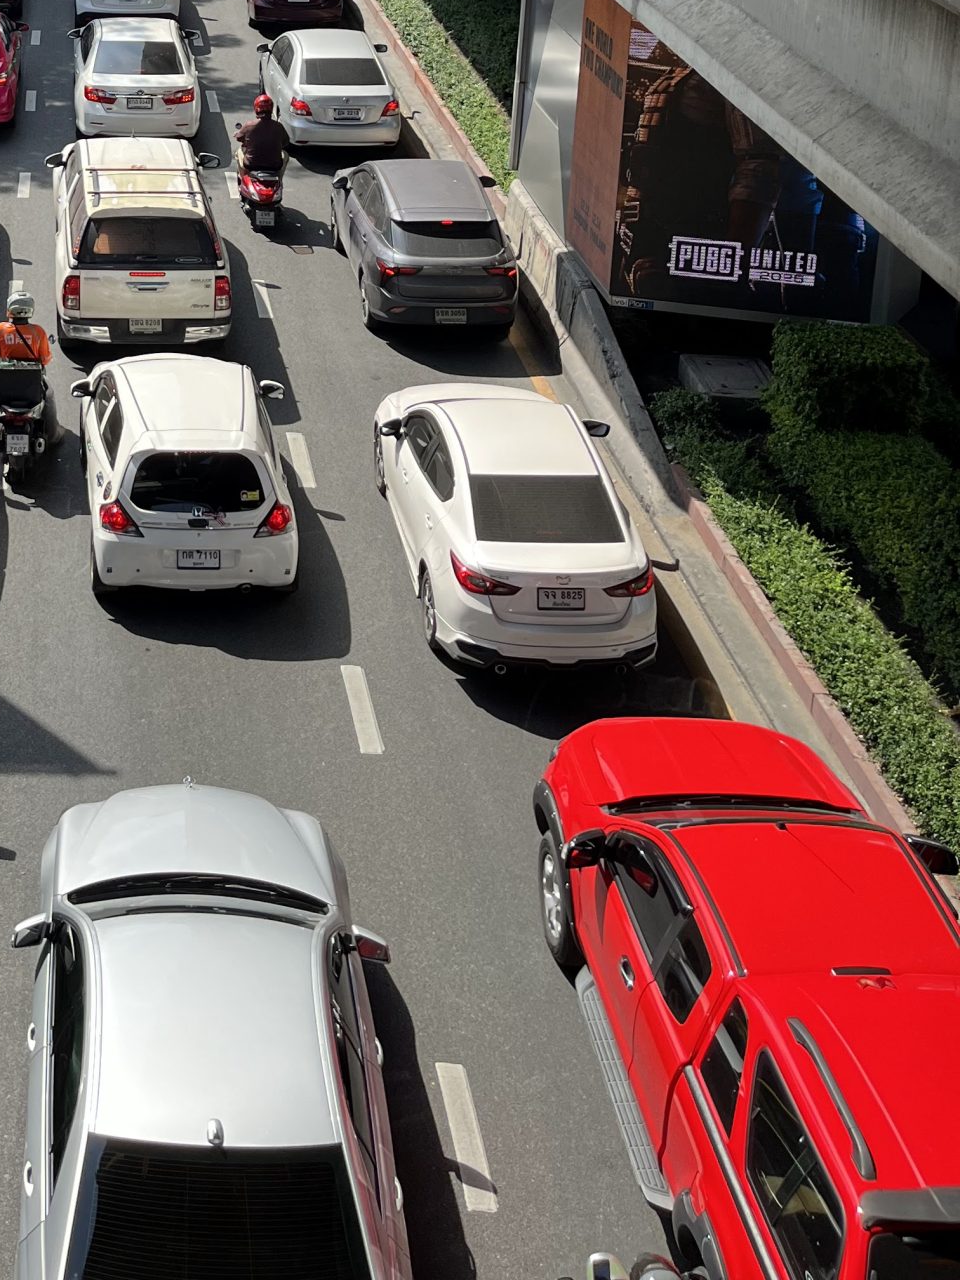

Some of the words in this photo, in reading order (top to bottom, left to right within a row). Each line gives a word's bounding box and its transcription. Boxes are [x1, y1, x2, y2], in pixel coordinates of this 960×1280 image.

[678, 244, 733, 274] PUBG
[749, 247, 818, 274] UNITED
[197, 551, 218, 560] 7110
[543, 590, 557, 600] จจ
[560, 590, 583, 600] 8825
